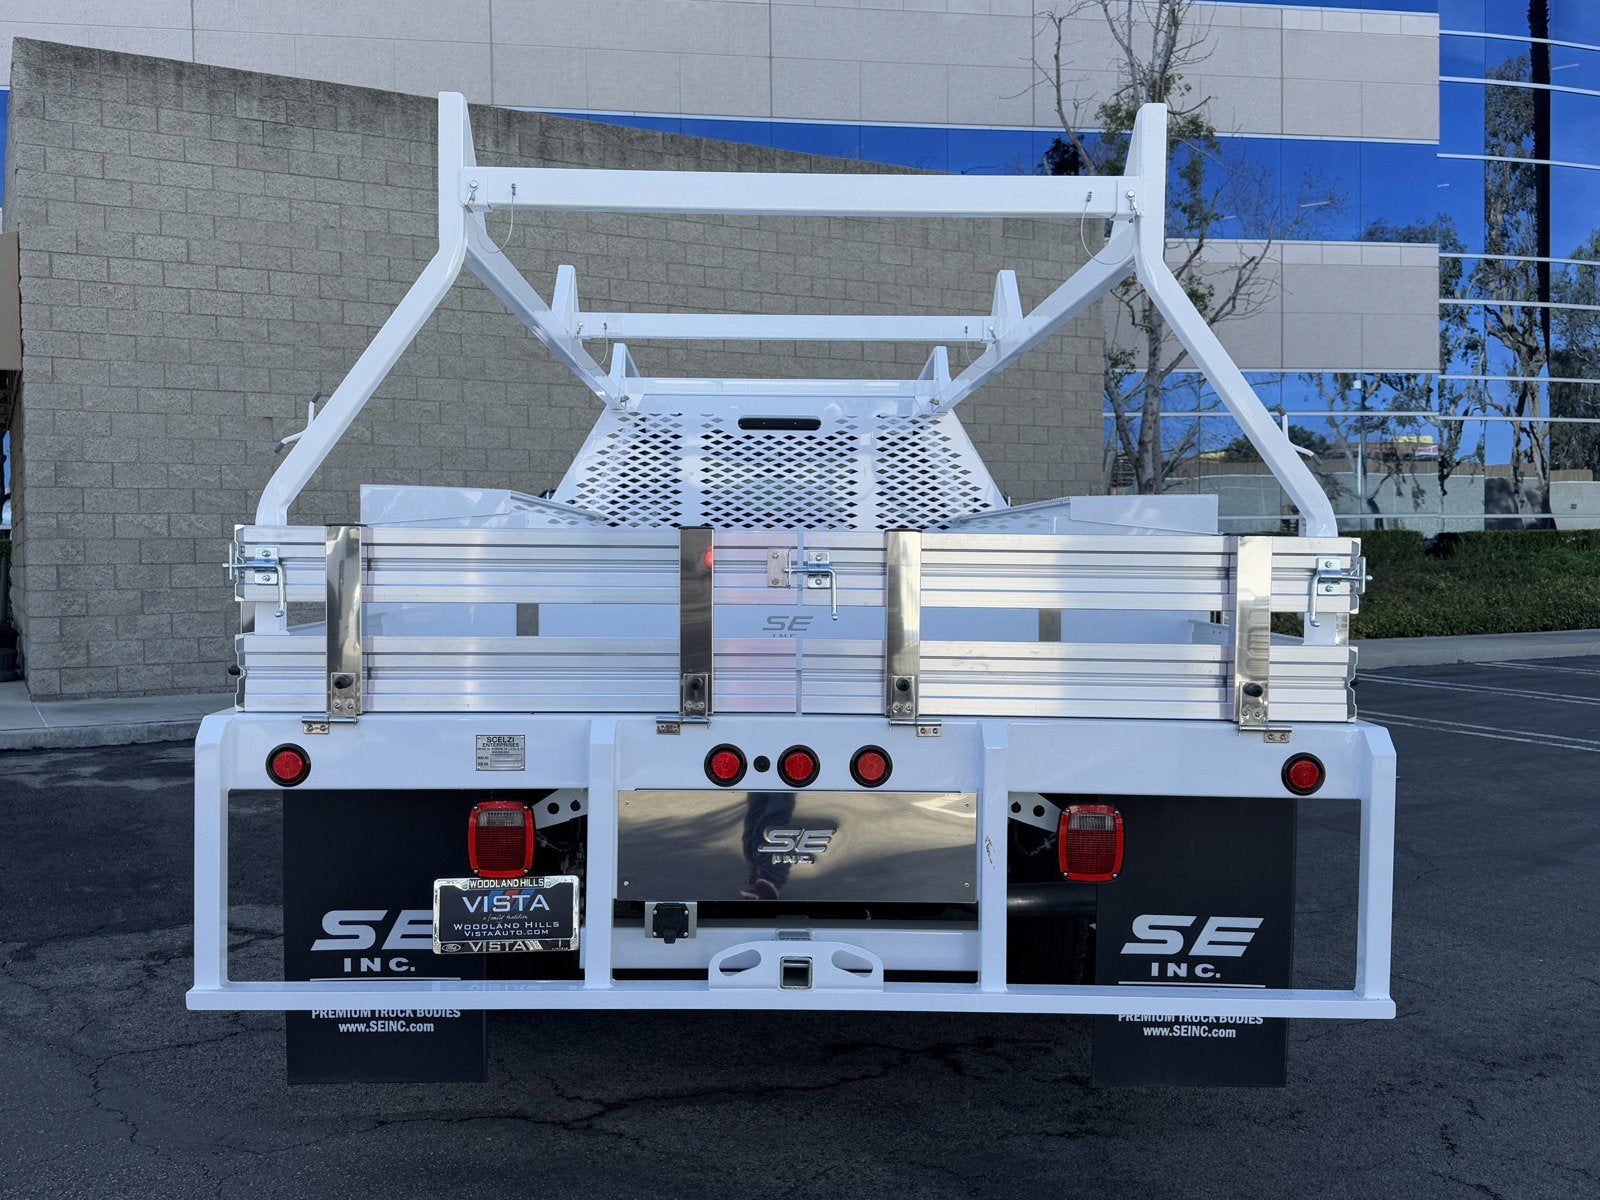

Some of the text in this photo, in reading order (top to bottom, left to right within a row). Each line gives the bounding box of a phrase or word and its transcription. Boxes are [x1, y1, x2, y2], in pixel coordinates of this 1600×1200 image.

[762, 615, 815, 631] SE
[757, 828, 837, 853] SE
[469, 878, 544, 888] WOODLAND HILLS
[462, 894, 551, 913] VISTA
[310, 909, 433, 951] SE
[1120, 914, 1265, 957] SE
[469, 940, 528, 952] VISTA
[344, 957, 416, 972] INC.
[1150, 962, 1221, 978] INC.
[311, 1008, 371, 1018] PREMIUM
[338, 1020, 435, 1033] www.SEINC.com
[1142, 1024, 1237, 1038] www.SEINC.com
